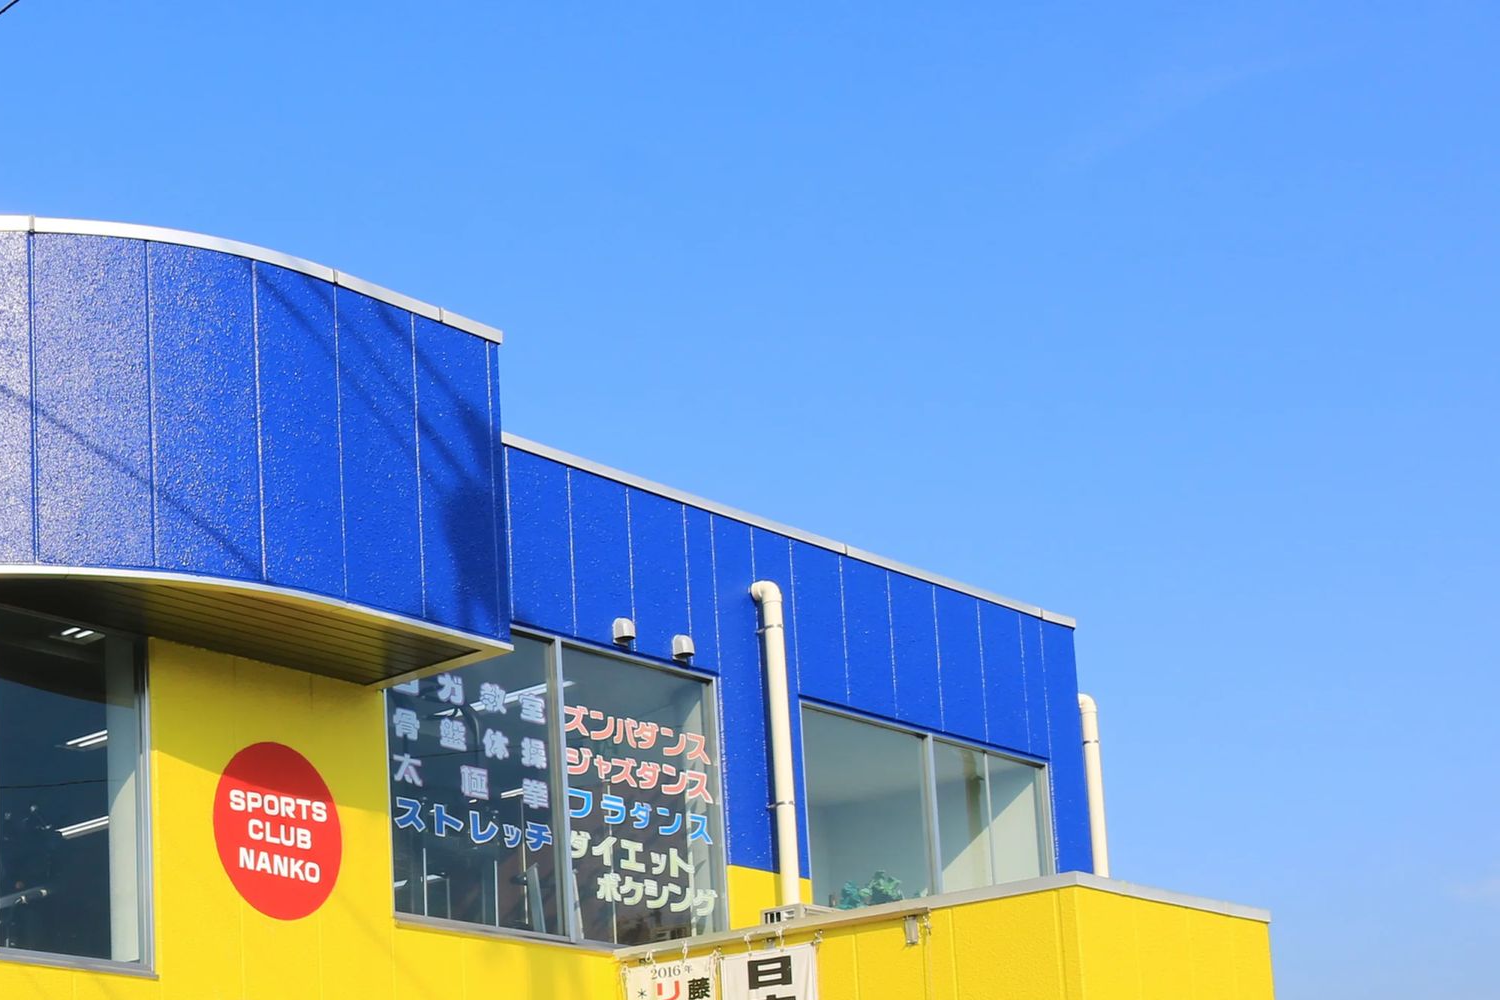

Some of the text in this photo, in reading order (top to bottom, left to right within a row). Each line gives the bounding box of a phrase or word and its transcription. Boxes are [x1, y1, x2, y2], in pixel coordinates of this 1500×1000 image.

[393, 707, 547, 769] 骨盤体操
[564, 705, 712, 765] ズンバダンス
[393, 753, 549, 809] 太極拳
[566, 747, 713, 804] ジャズダンス
[229, 789, 328, 823] SPORTS
[394, 796, 553, 851] ストレッチ
[567, 787, 713, 845] フラダンス
[248, 819, 312, 850] CLUB
[570, 830, 696, 878] ダイエット
[239, 847, 321, 883] NANKO
[597, 872, 718, 917] ボクシング
[650, 964, 692, 980] 2016年
